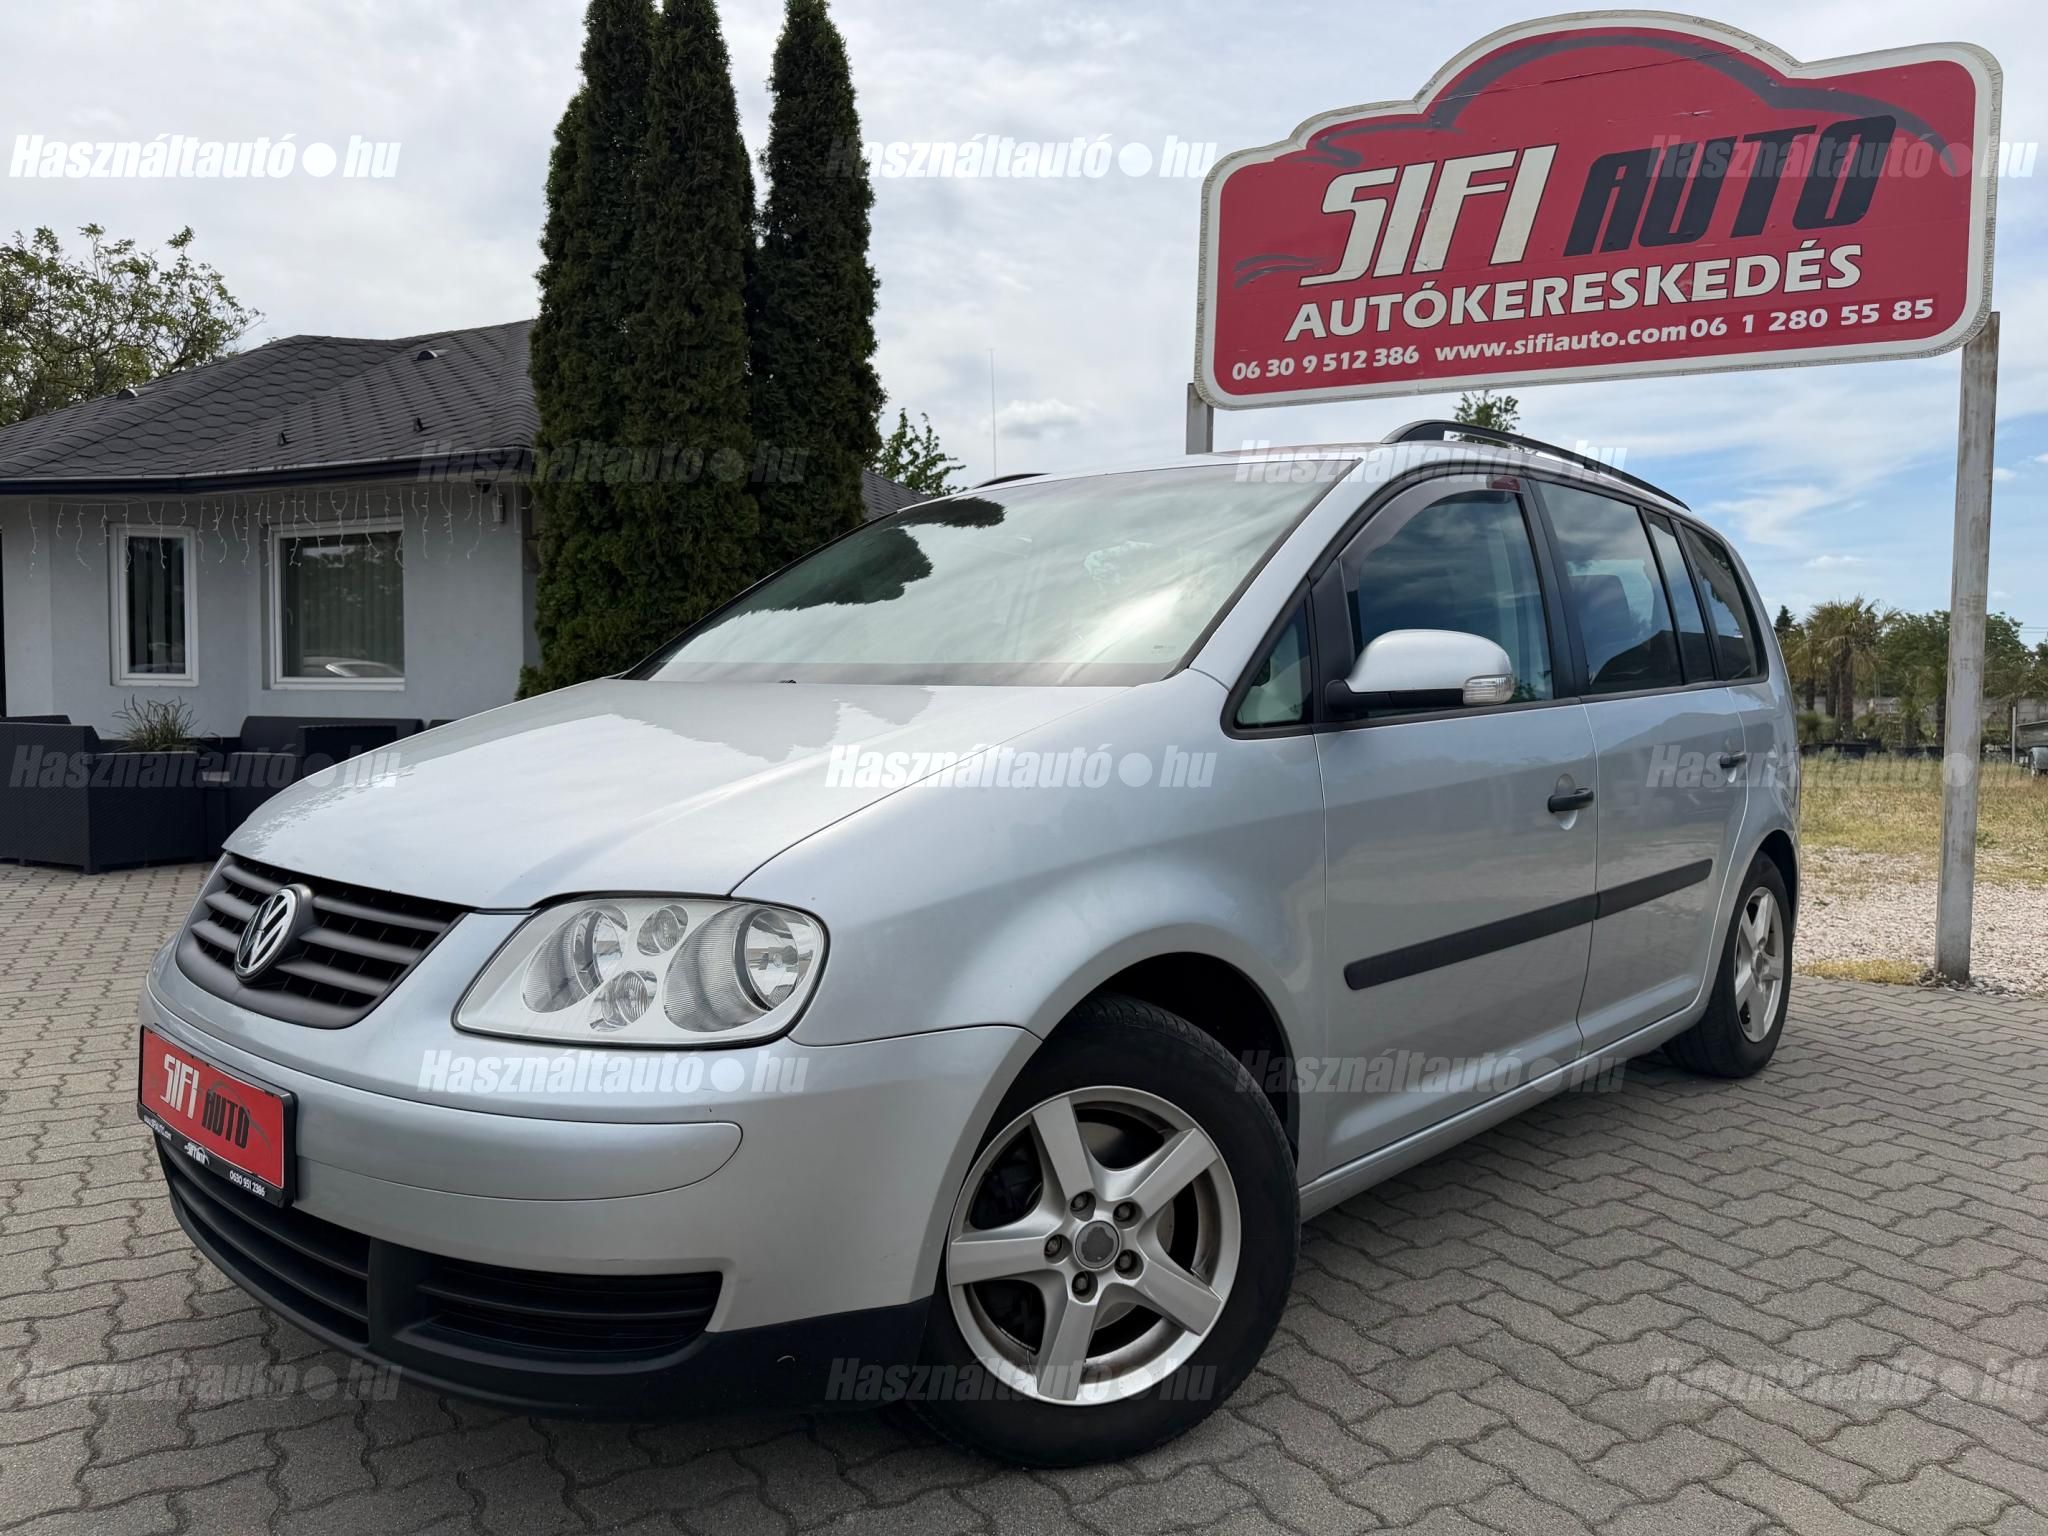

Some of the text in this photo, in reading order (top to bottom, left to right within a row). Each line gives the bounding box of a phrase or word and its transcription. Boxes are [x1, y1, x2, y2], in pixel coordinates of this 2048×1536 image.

[1299, 114, 1897, 287] SIFI AUTO
[1232, 298, 1934, 380] 06 30 9 512 386 www.sifiauto.com 06 1 280 55 85
[1283, 239, 1863, 342] AUTÓKERESKEDÉS
[160, 1053, 199, 1119] SIFI
[202, 1090, 250, 1149] AUTO
